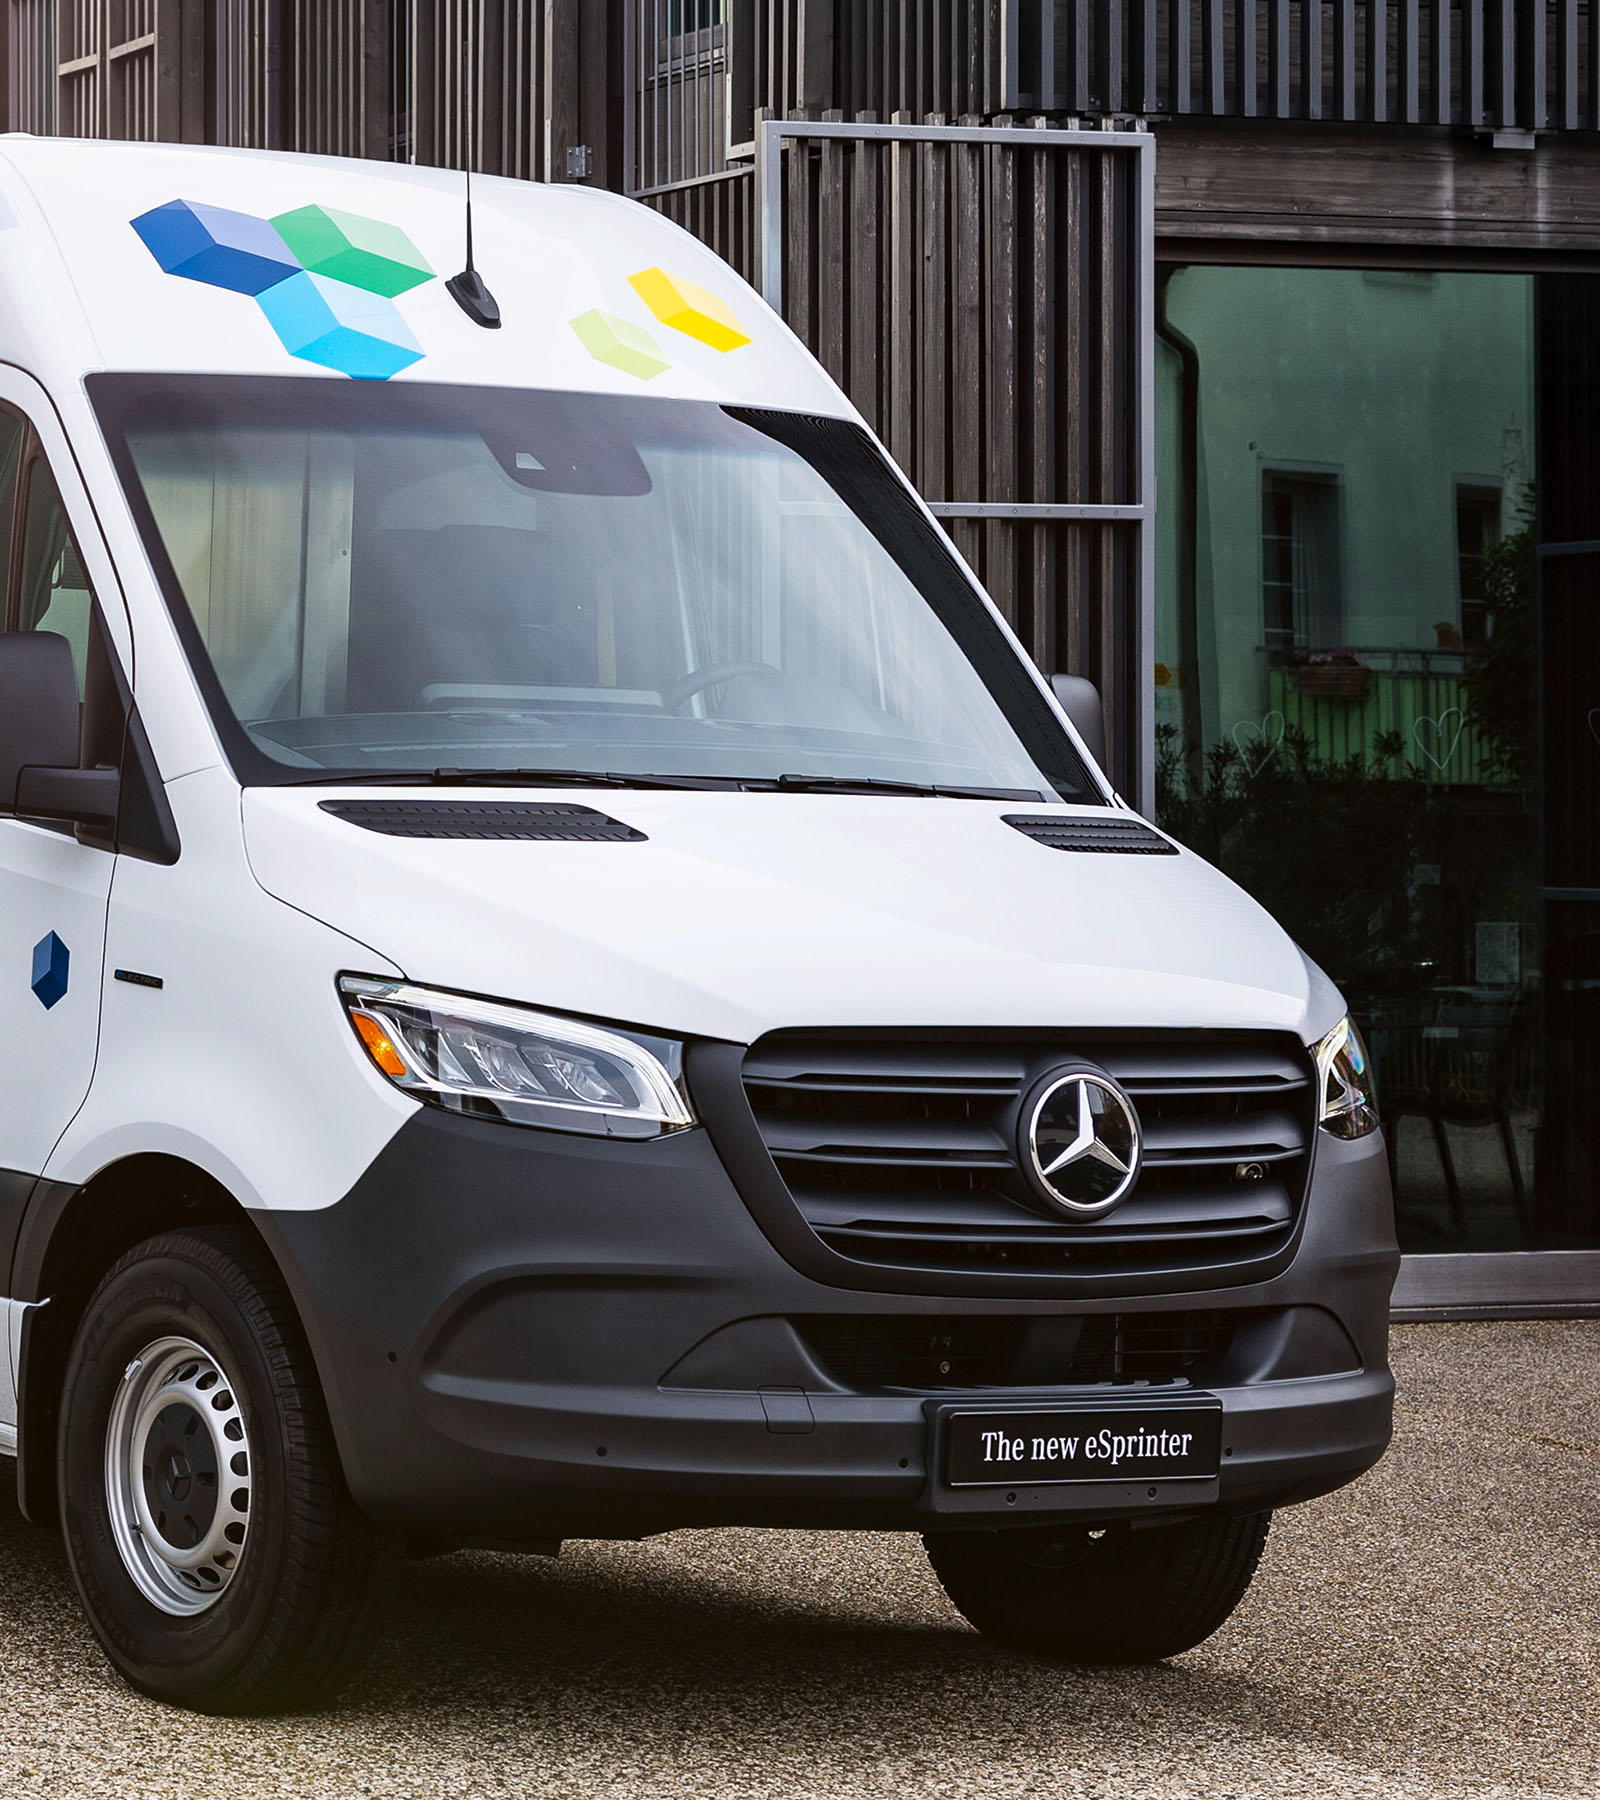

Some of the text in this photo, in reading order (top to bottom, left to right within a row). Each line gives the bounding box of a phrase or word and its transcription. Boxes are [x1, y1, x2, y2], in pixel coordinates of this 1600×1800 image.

[981, 1427, 1193, 1465] The new eSprinter
